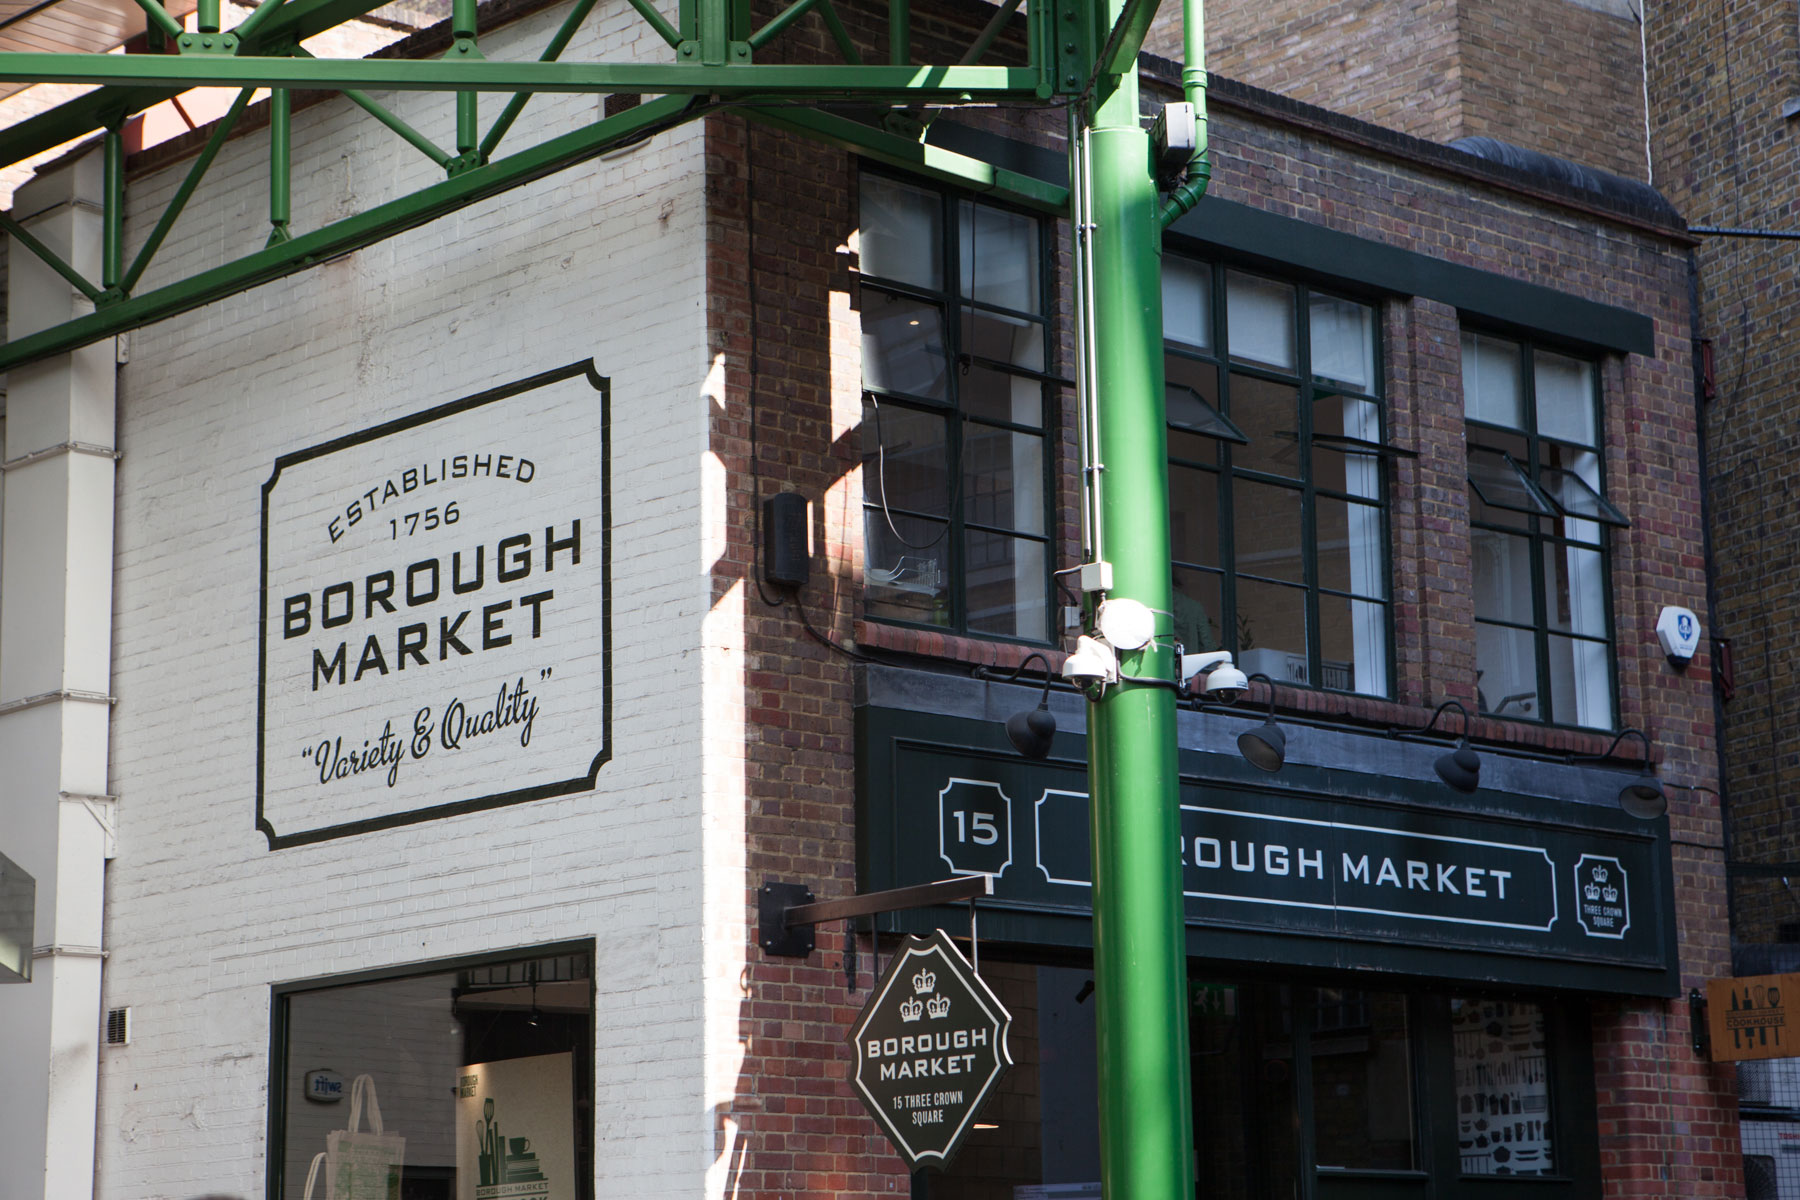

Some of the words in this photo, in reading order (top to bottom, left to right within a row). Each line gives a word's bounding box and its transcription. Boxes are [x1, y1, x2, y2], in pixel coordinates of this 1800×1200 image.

[328, 454, 535, 544] ESTABLISHED
[389, 501, 460, 540] 1756
[284, 518, 581, 640] BOROUGH
[312, 589, 554, 691] MARKET
[411, 706, 435, 759] &
[953, 810, 999, 845] 15
[1342, 853, 1512, 900] MARKET
[1584, 904, 1601, 915] THREE
[1727, 1017, 1784, 1027] COOKHOUSE
[868, 1028, 987, 1058] BOROUGH
[880, 1054, 976, 1081] MARKET
[893, 1096, 903, 1110] 15
[904, 1093, 932, 1109] THREE
[934, 1090, 963, 1106] CROWN
[912, 1109, 943, 1127] SQUARE
[476, 1186, 512, 1196] BOROUGH
[514, 1182, 548, 1192] MARKET
